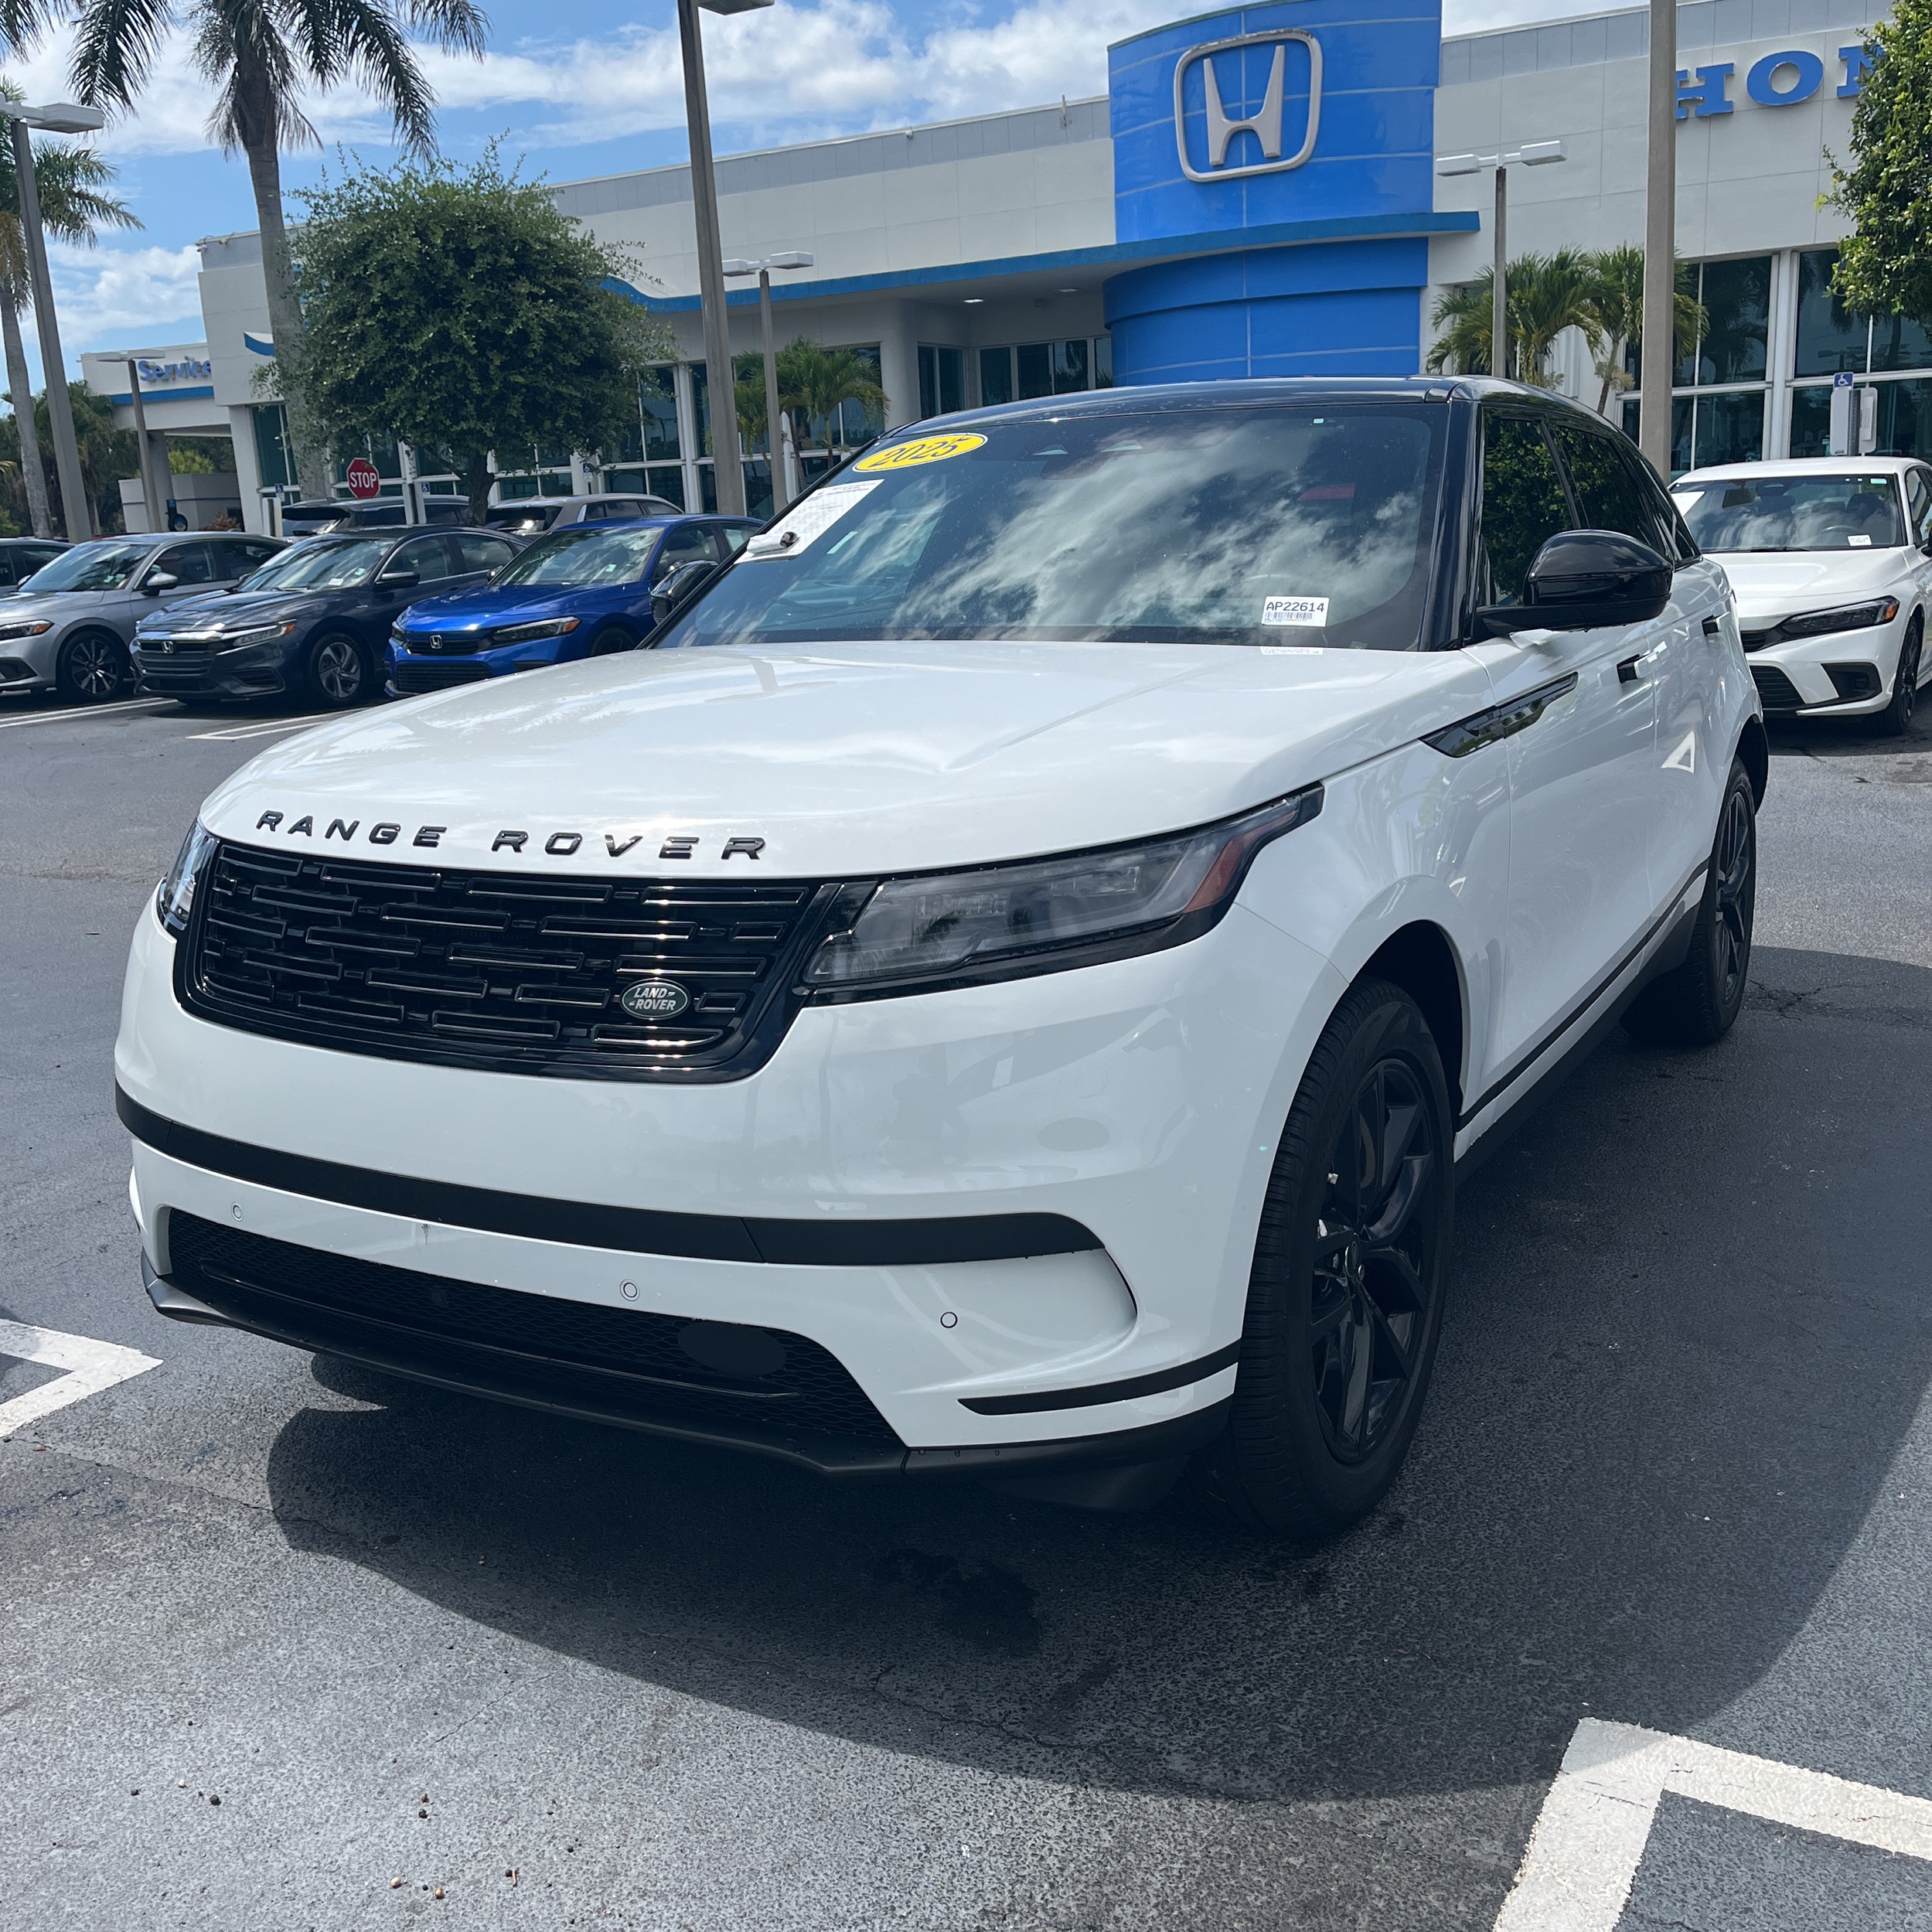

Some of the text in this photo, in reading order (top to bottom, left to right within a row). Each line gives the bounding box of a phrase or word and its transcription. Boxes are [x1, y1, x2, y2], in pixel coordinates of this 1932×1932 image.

[138, 355, 211, 382] Service
[867, 438, 972, 468] 2025
[349, 472, 377, 489] STOP
[1266, 601, 1324, 612] AP22614
[256, 809, 766, 860] RANGE ROVER
[633, 987, 668, 999] LAND
[634, 998, 676, 1010] ROVER
